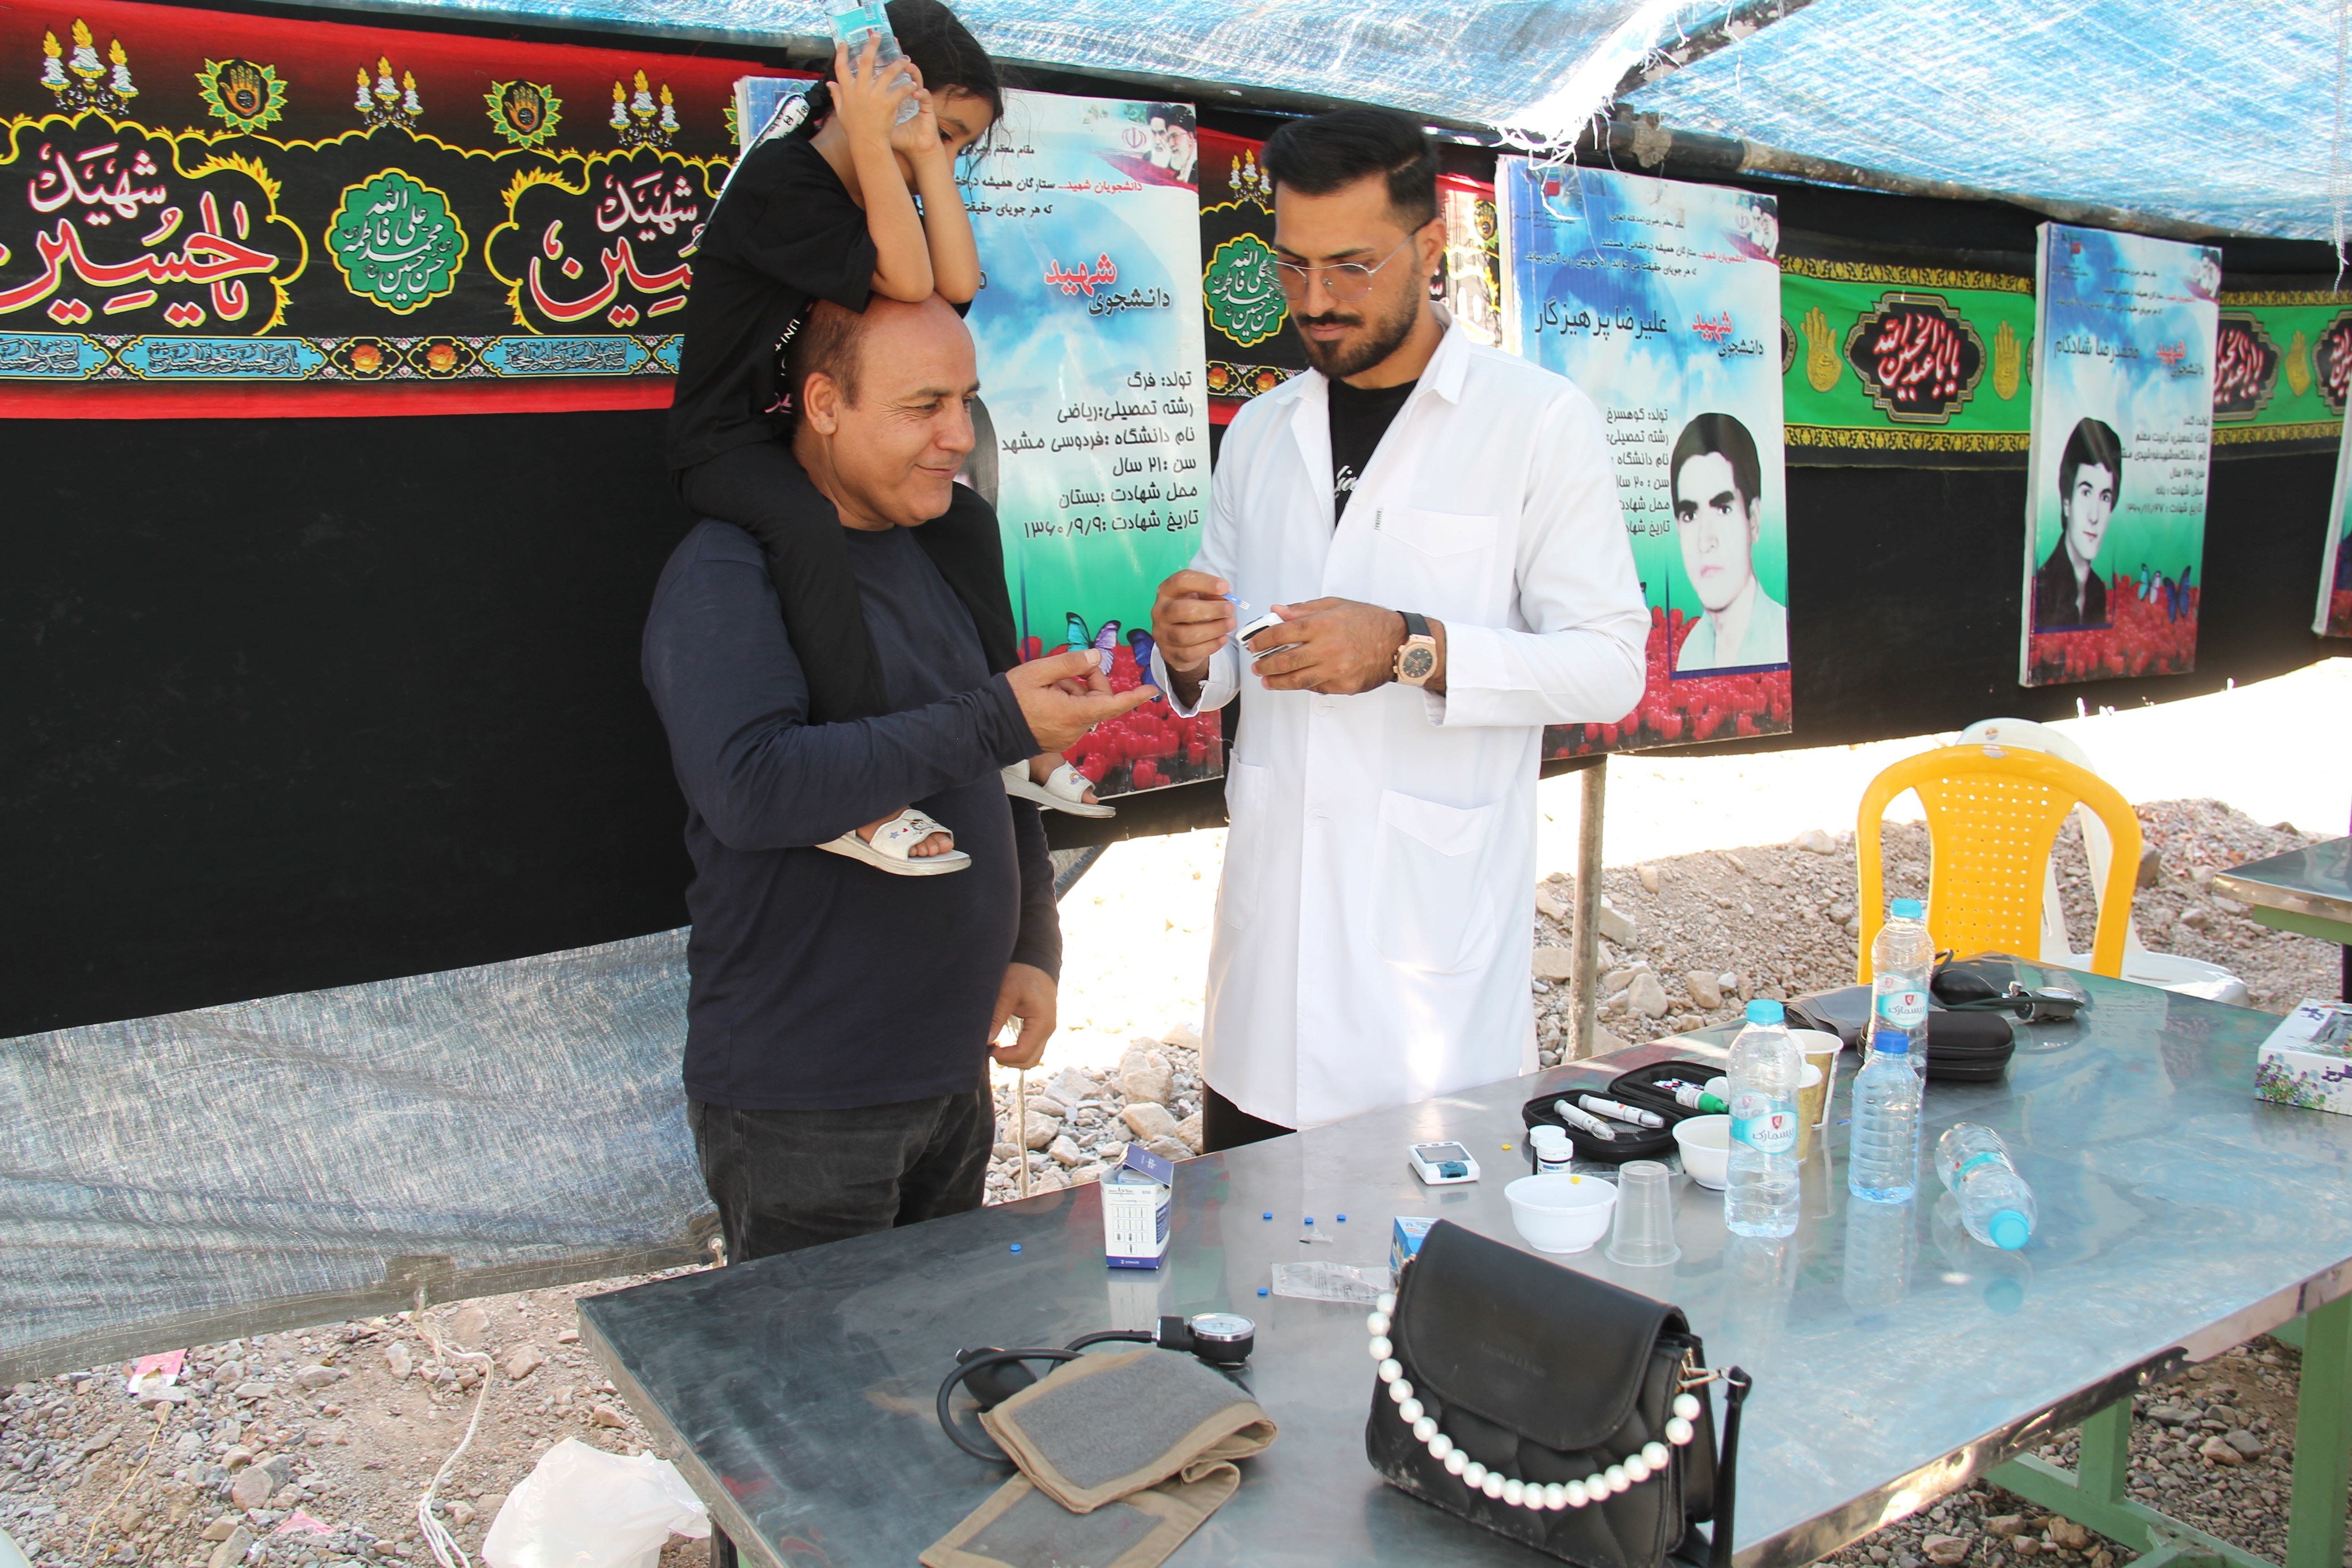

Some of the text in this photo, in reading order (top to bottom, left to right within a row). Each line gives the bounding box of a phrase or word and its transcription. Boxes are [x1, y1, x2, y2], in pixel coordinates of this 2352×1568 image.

[1018, 145, 1035, 158] مقام
[982, 176, 1012, 190] همیشه
[1016, 177, 1055, 193] ستارگان
[1094, 180, 1143, 195] دانشجویان
[365, 181, 408, 217] الله
[995, 203, 1026, 217] جویای
[1029, 206, 1040, 219] هر
[1044, 204, 1053, 214] که
[395, 204, 427, 247] علی
[358, 224, 444, 262] محمد
[1045, 252, 1116, 295] شهید
[1088, 287, 1171, 316] دانشجوی
[1615, 306, 1667, 341] علیرضا
[1692, 309, 1732, 341] شهید
[1717, 338, 1764, 358] دانشجوی
[1163, 397, 1194, 418] رشته
[1001, 430, 1045, 454] مشهد
[1114, 426, 1170, 444] دانشگاه
[1176, 427, 1195, 448] نام
[1648, 429, 1669, 446] رشته
[1113, 457, 1142, 476] سال
[1173, 458, 1196, 472] سن
[1617, 451, 1669, 468] نام دانشگاه
[1111, 482, 1161, 502] شهادت
[1166, 483, 1197, 500] محل
[1654, 479, 1670, 490] سن
[1649, 497, 1670, 513] محل
[1112, 510, 1161, 531] شهادت
[1167, 510, 1199, 532] تاریخ
[1626, 518, 1671, 537] تاریخ شهاد
